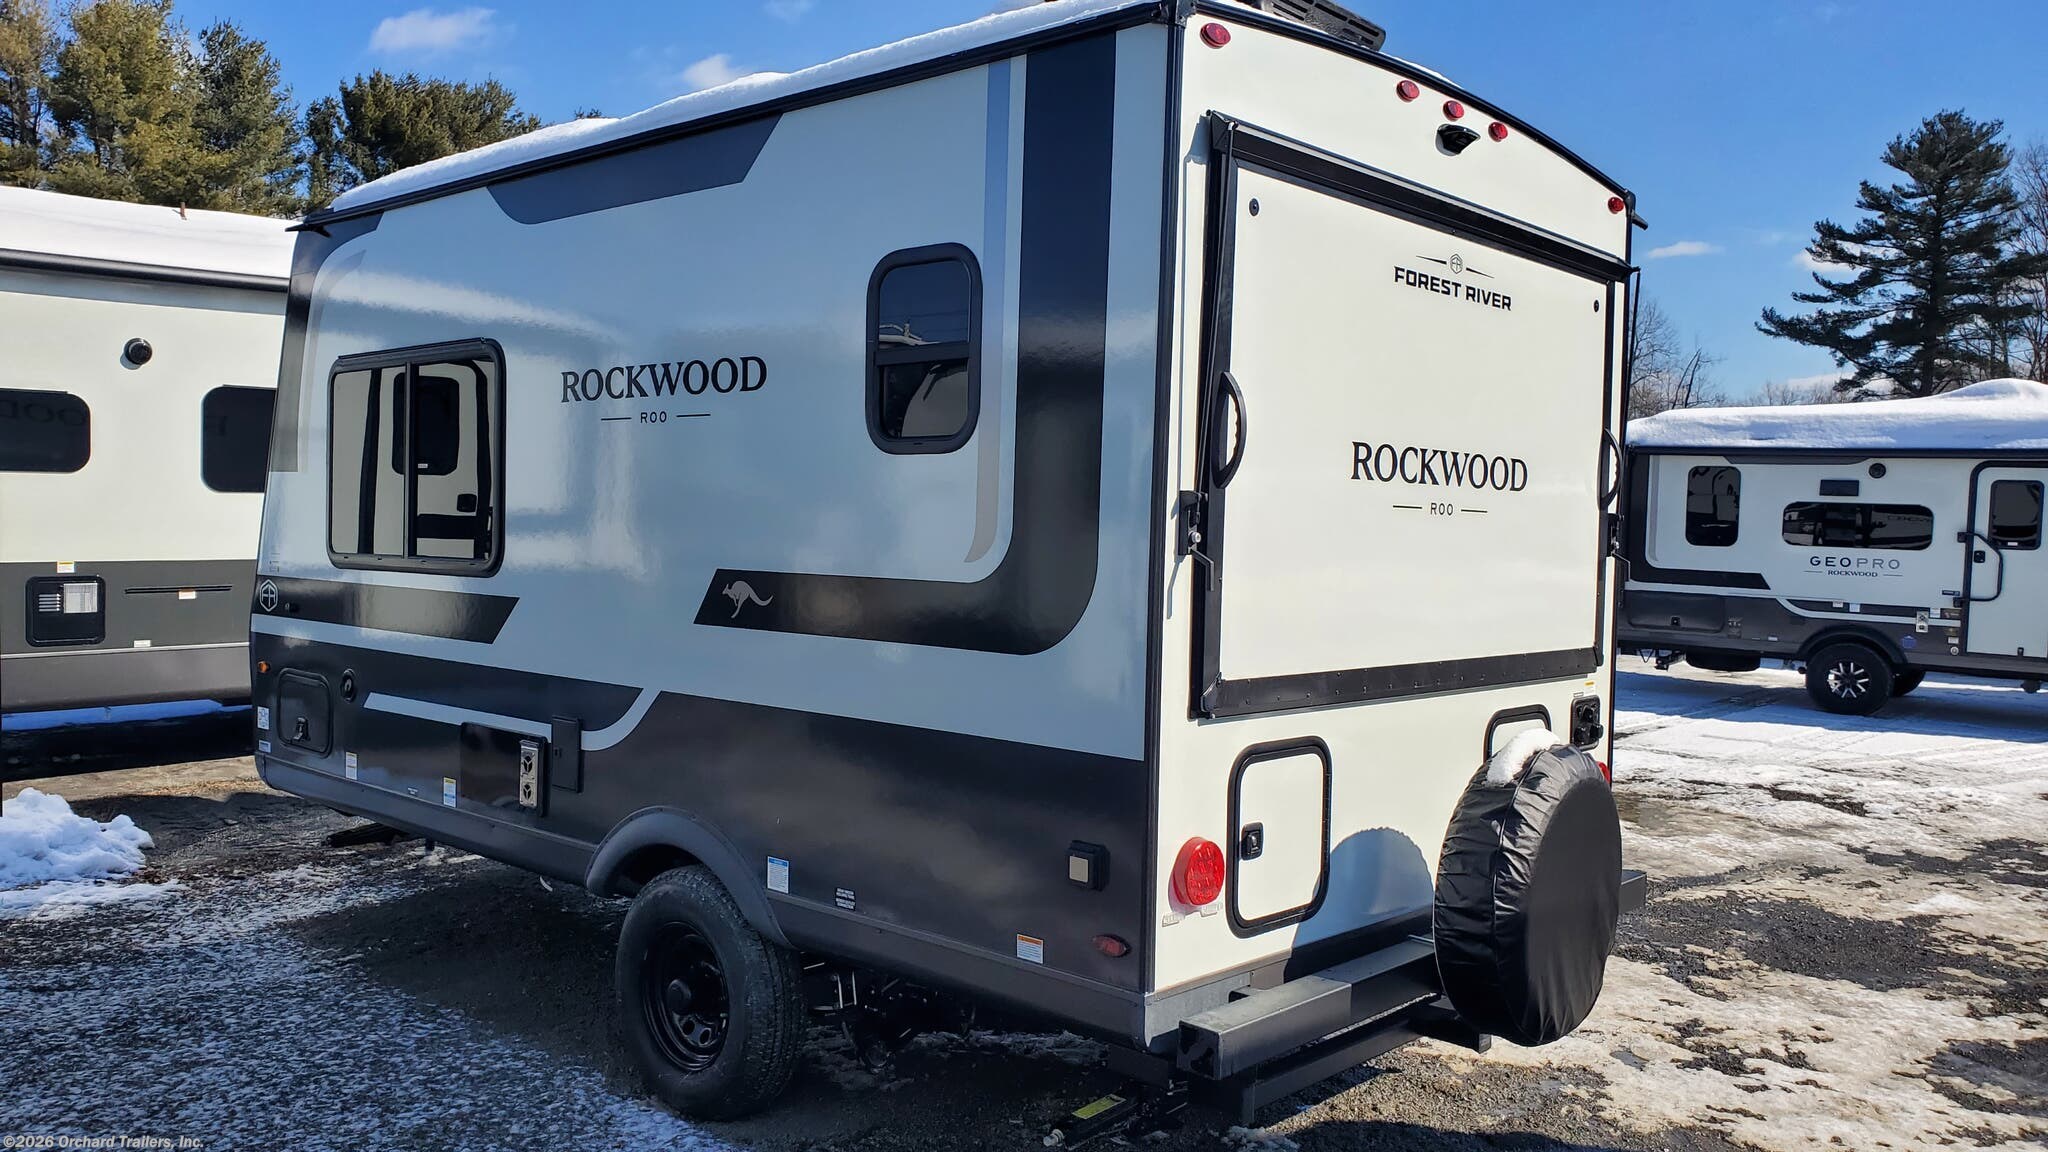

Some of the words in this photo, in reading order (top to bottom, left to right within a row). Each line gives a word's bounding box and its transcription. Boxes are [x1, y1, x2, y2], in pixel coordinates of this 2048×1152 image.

[1393, 266, 1462, 298] FOREST
[1465, 285, 1512, 311] RIVER
[561, 356, 767, 403] ROCKWOOD
[640, 411, 667, 424] ROO
[1351, 441, 1528, 492] ROCKWOOD
[1430, 502, 1454, 516] ROO
[1828, 569, 1878, 578] ROCKWOOD
